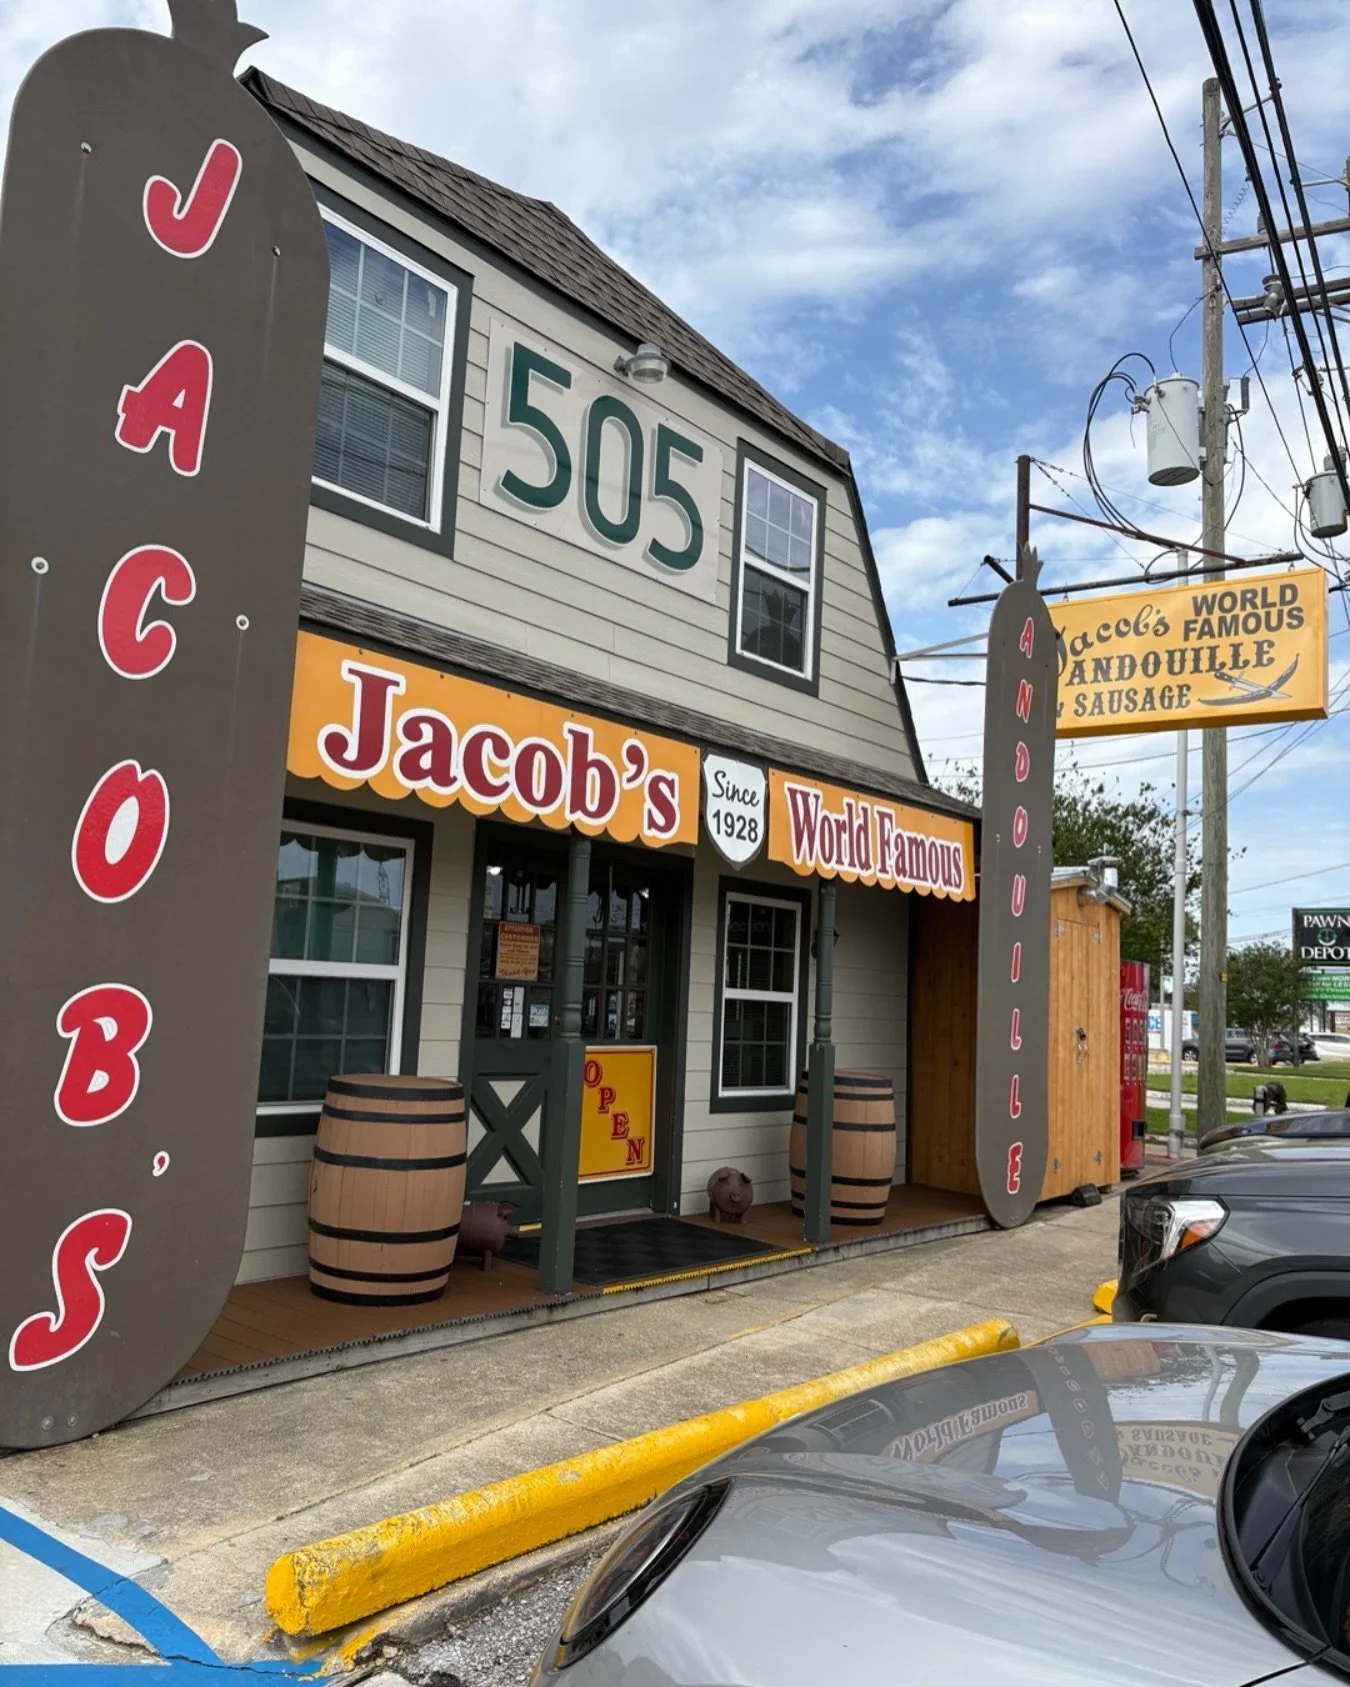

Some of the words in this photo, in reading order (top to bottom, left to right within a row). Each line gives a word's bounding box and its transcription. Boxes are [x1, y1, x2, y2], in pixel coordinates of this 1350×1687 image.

[500, 341, 704, 571] 505
[1192, 583, 1299, 618] WORLD
[1183, 606, 1305, 641] FAMOUS
[1065, 639, 1275, 686] ANDOUILLE
[1074, 684, 1191, 717] SAUSAGE
[9, 138, 243, 1372] JACOB'S
[318, 660, 680, 839] Jacob's
[712, 770, 760, 807] Since
[712, 809, 758, 843] 1928
[785, 782, 873, 876] World
[874, 807, 965, 892] Famous
[1006, 616, 1036, 1194] ANDOUILLE
[1303, 914, 1350, 928] PAWN
[1301, 946, 1350, 960] DEPOT
[584, 1060, 646, 1166] OPEN
